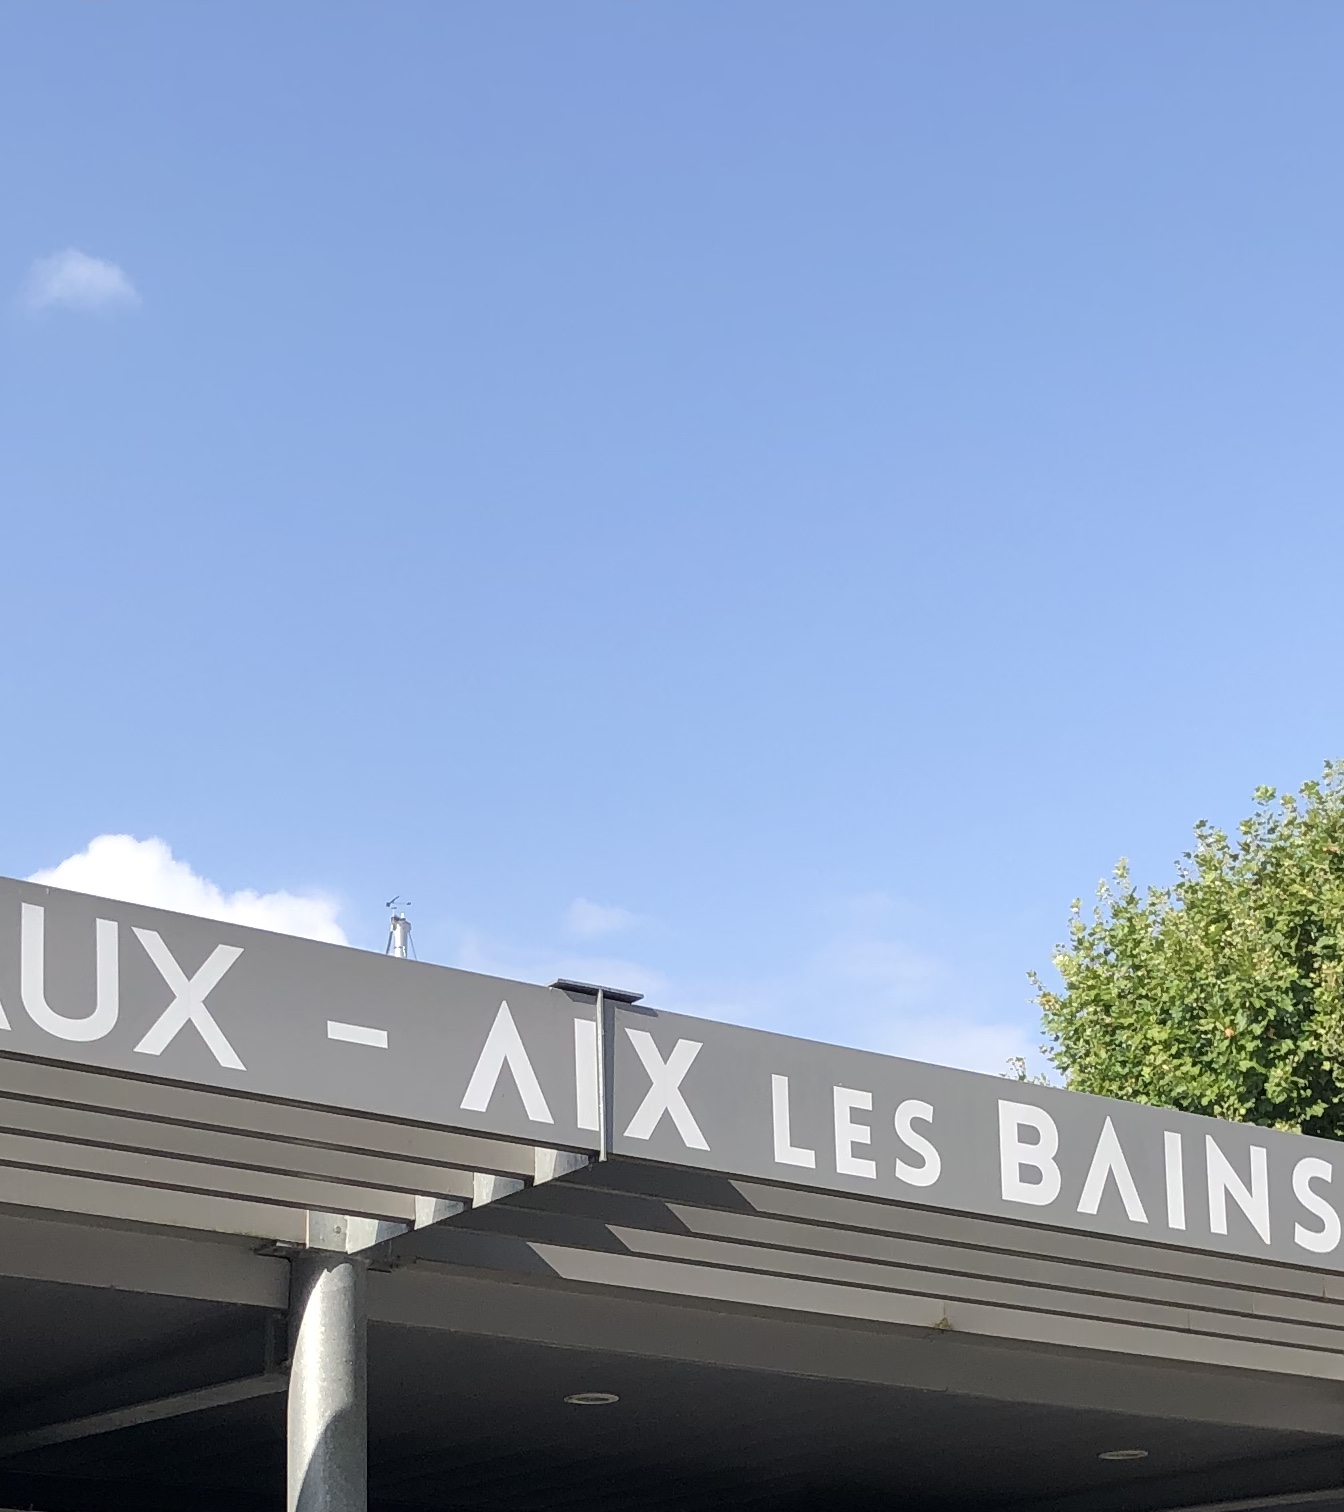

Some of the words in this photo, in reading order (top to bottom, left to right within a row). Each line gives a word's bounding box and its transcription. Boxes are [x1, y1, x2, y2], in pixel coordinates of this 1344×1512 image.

[460, 1000, 710, 1151] AIX
[772, 1074, 942, 1187] LES
[998, 1100, 1341, 1254] BAINS
